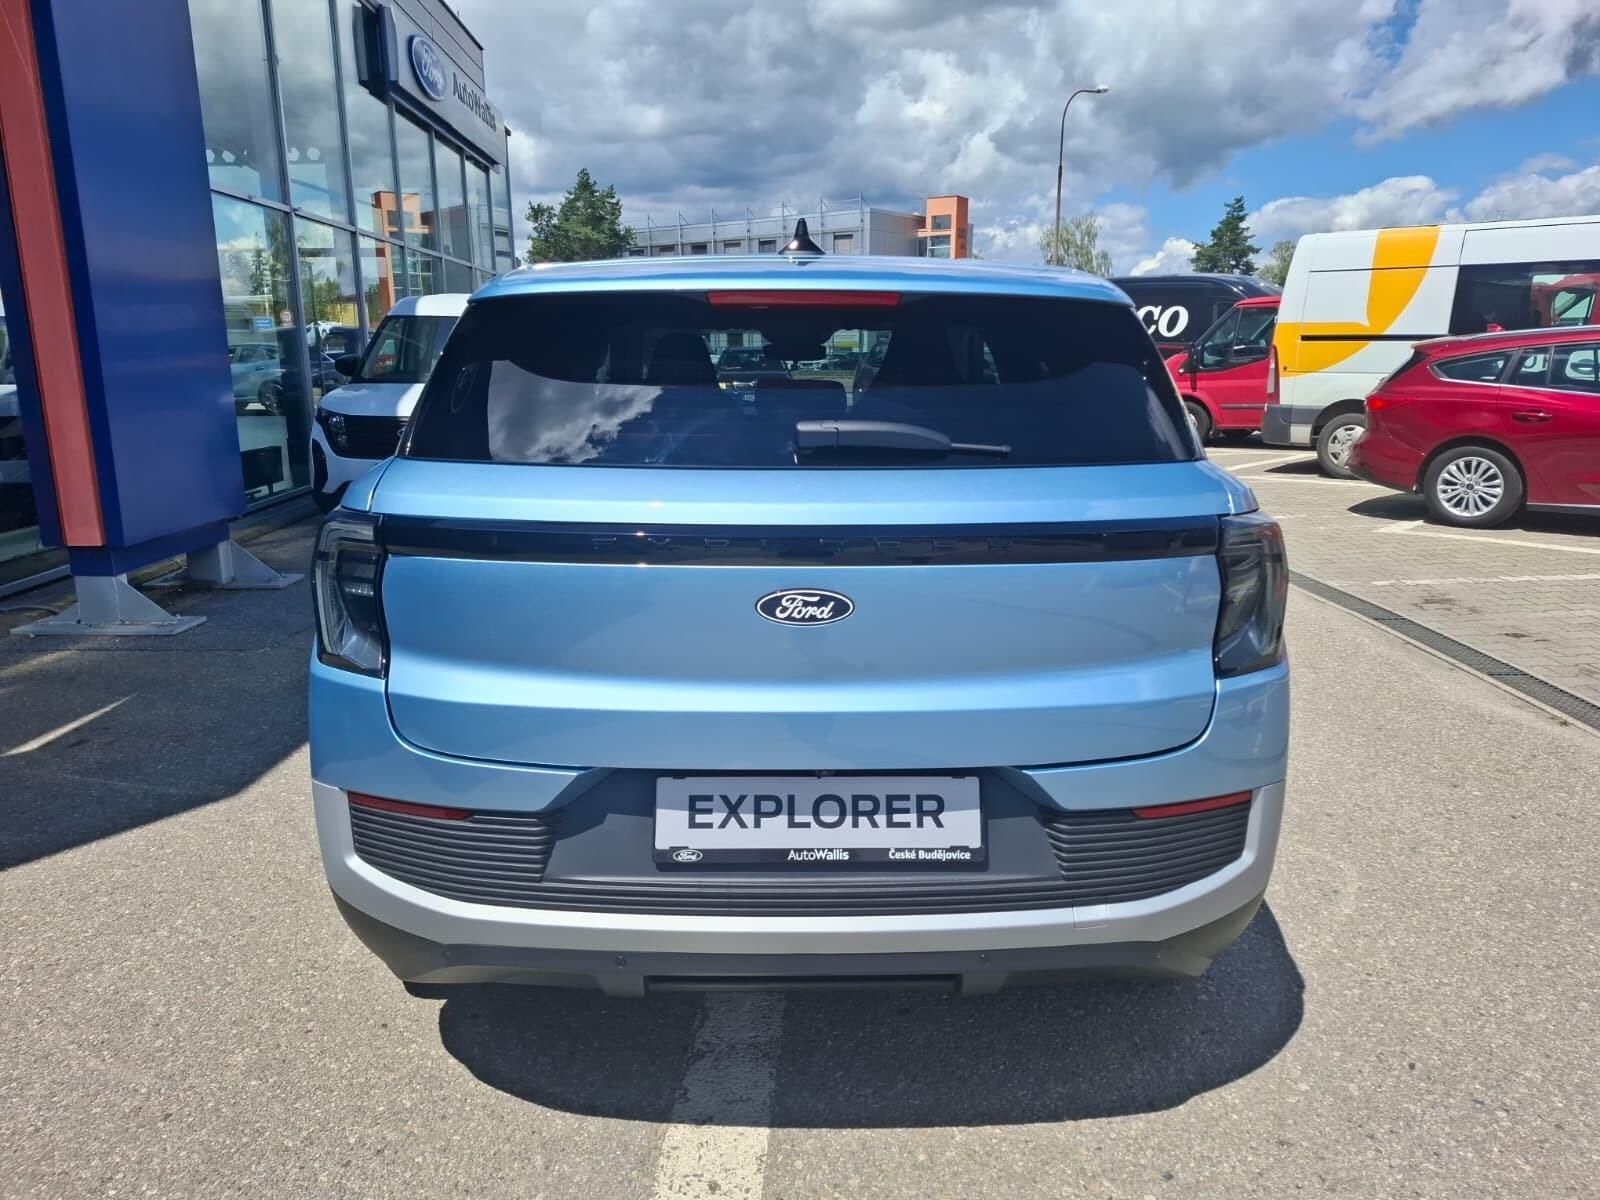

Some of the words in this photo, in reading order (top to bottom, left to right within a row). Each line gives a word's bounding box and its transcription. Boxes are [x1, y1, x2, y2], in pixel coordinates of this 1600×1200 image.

[775, 594, 835, 619] Ford
[687, 793, 946, 830] EXPLORER
[787, 848, 850, 861] AutoWallis
[888, 847, 917, 860] České
[918, 848, 971, 861] Budějovice
